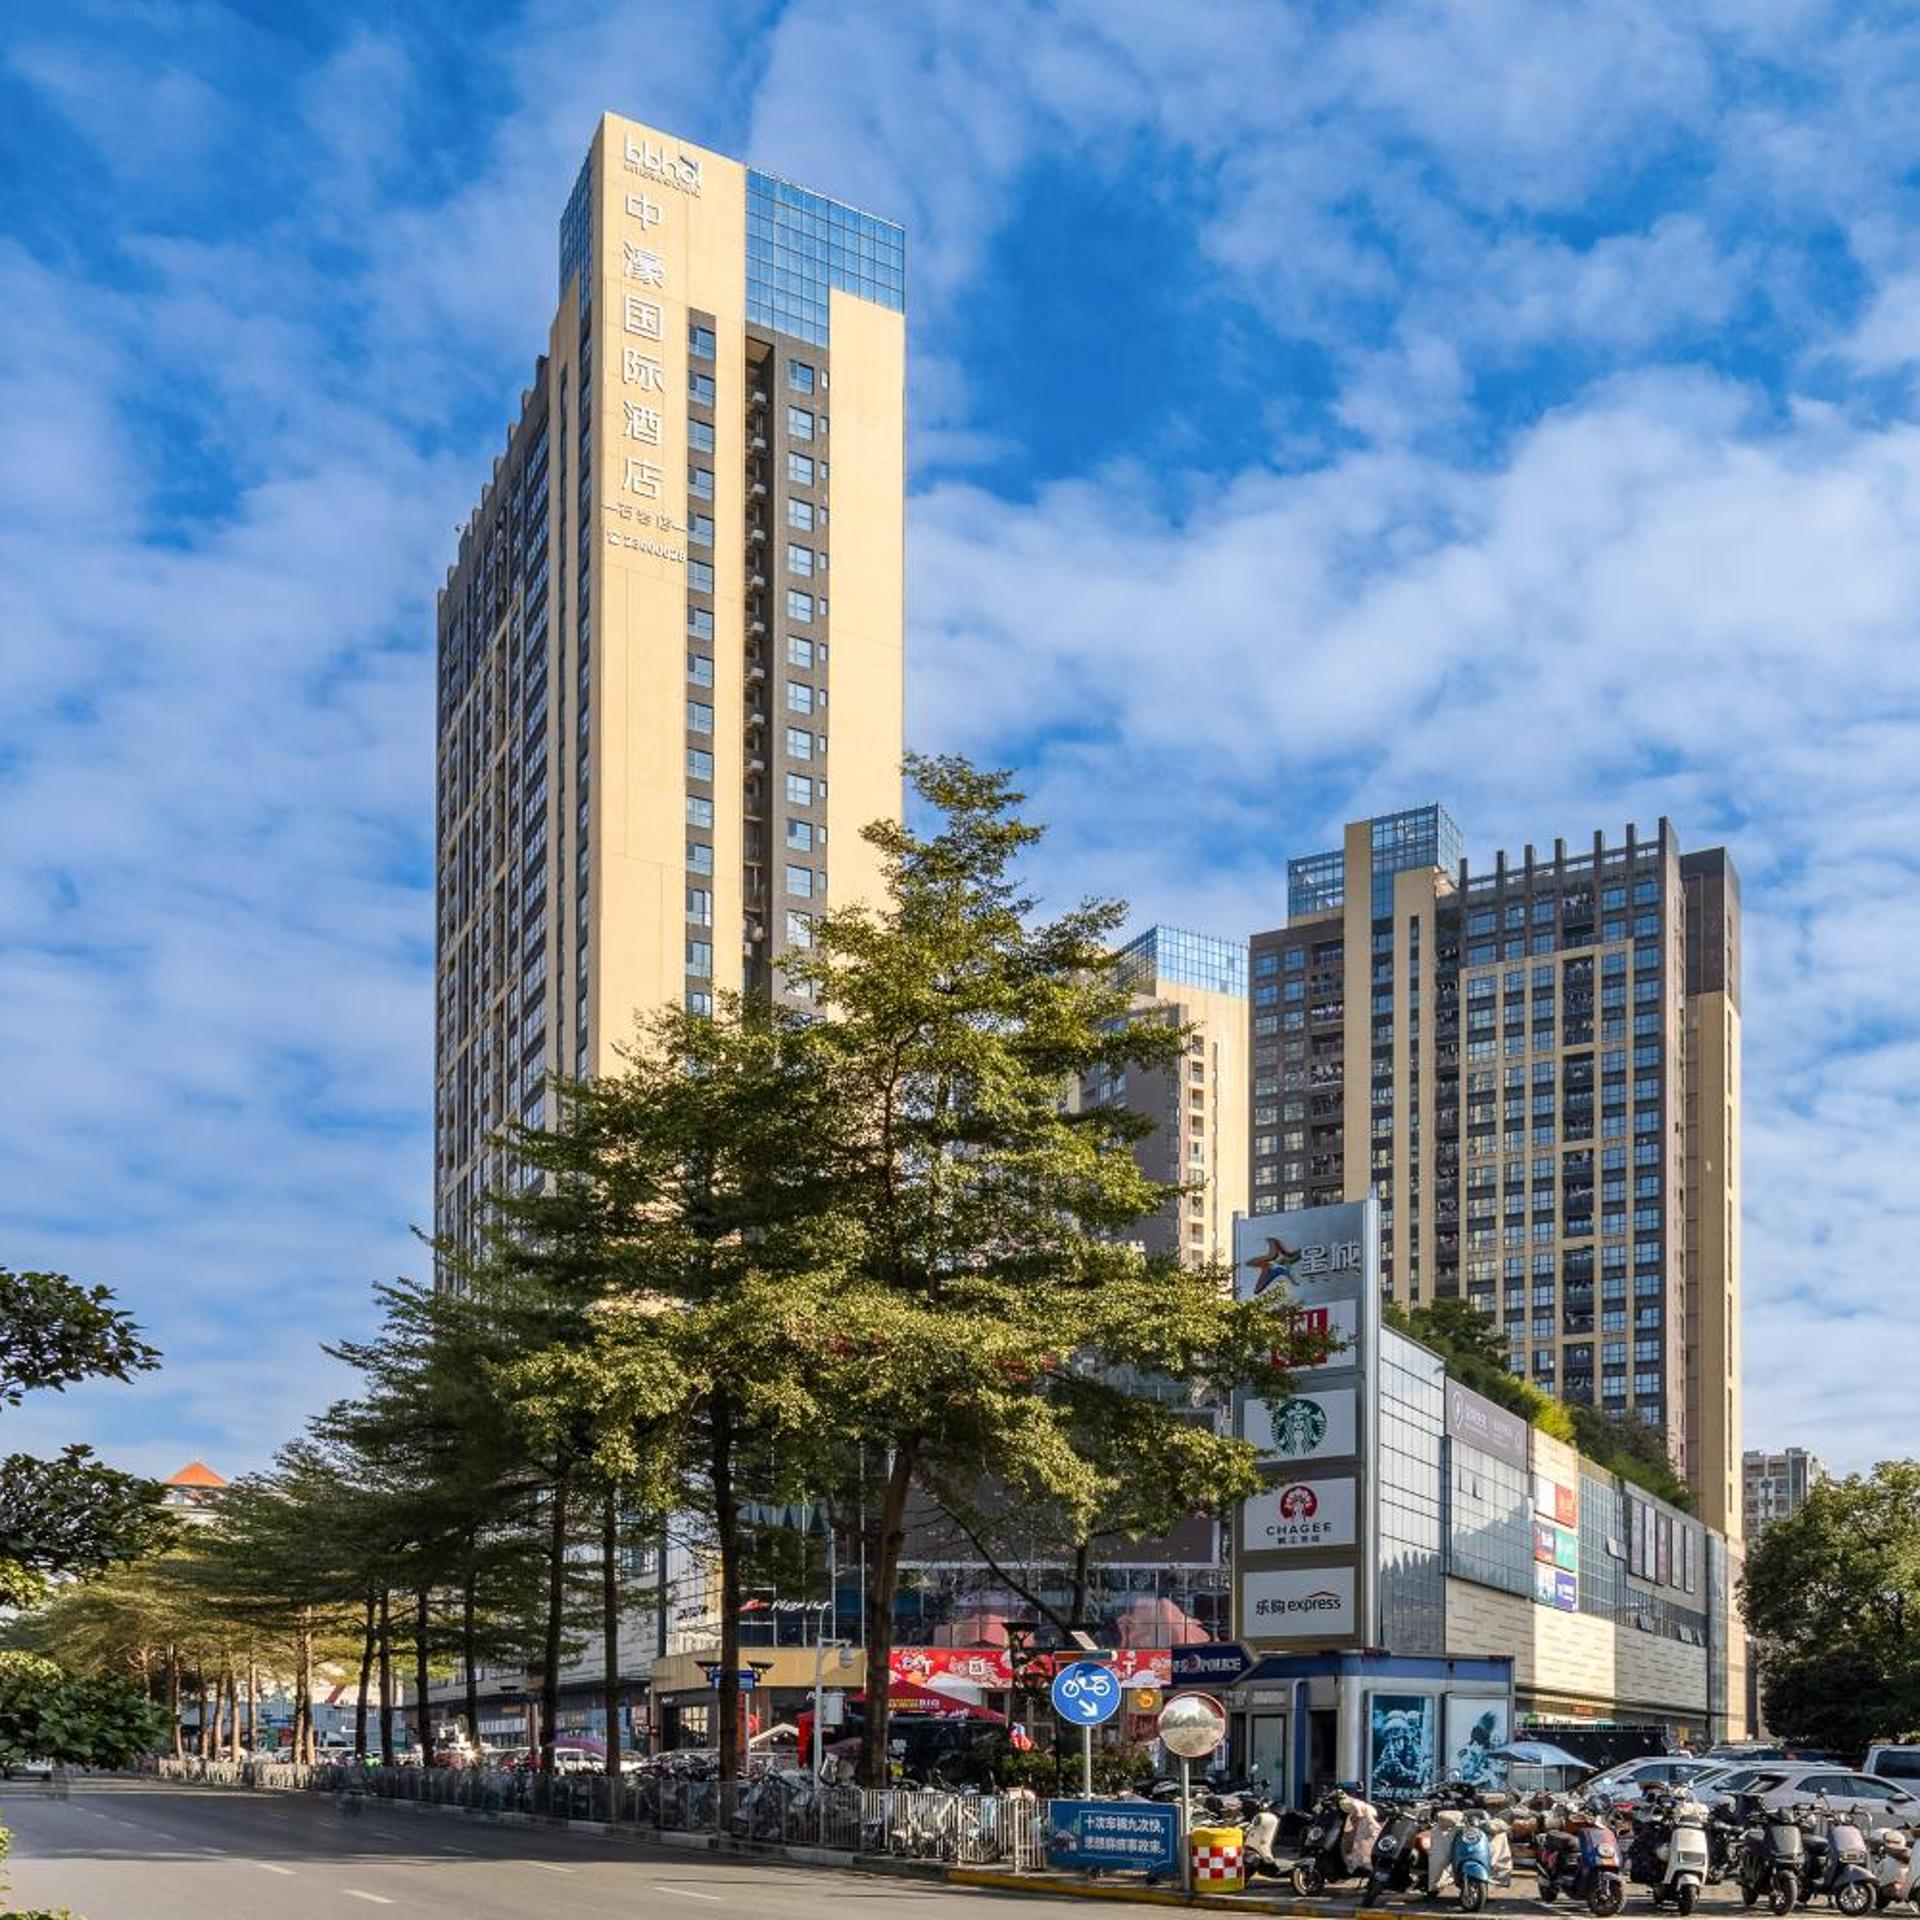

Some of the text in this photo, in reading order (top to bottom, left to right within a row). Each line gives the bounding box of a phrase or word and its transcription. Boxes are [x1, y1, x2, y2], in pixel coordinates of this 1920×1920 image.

[1266, 1522, 1332, 1536] CHAGEE
[1256, 1598, 1341, 1616] 乐购 express
[1201, 1657, 1241, 1672] POLICE
